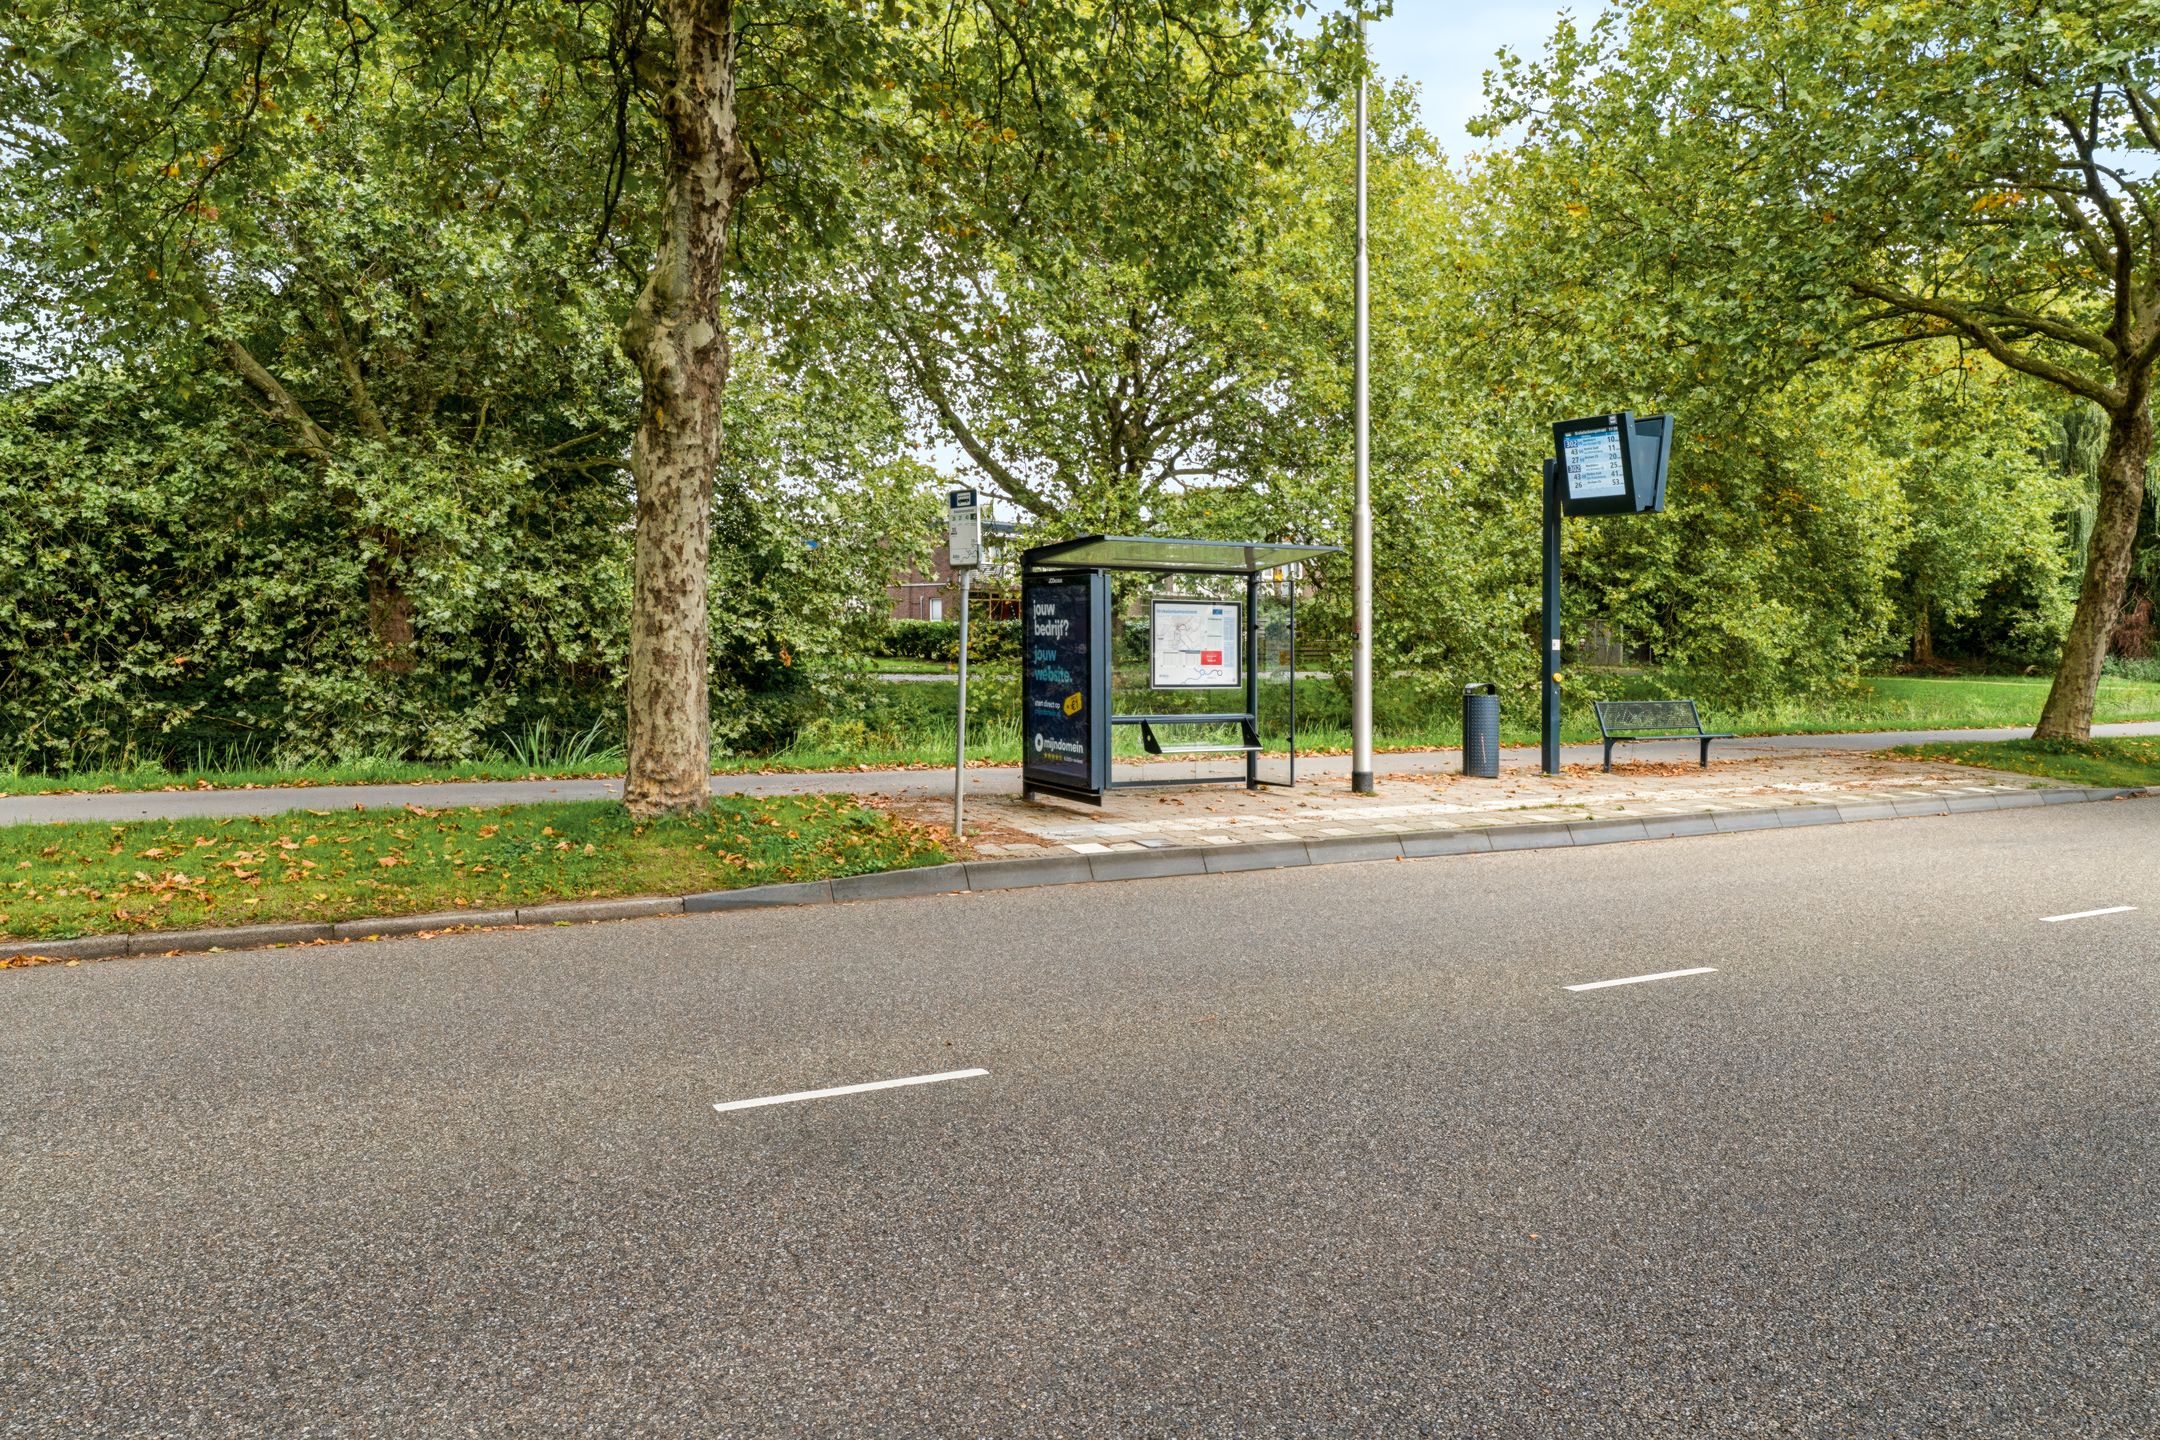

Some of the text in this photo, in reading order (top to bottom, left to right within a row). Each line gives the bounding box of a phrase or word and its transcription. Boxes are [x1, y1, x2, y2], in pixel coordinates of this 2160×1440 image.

[1033, 600, 1056, 620] jouw
[1034, 620, 1069, 640] bedrijf?
[1034, 644, 1056, 664] jouw
[1034, 665, 1072, 682] website.
[1044, 737, 1084, 754] mijndomein
